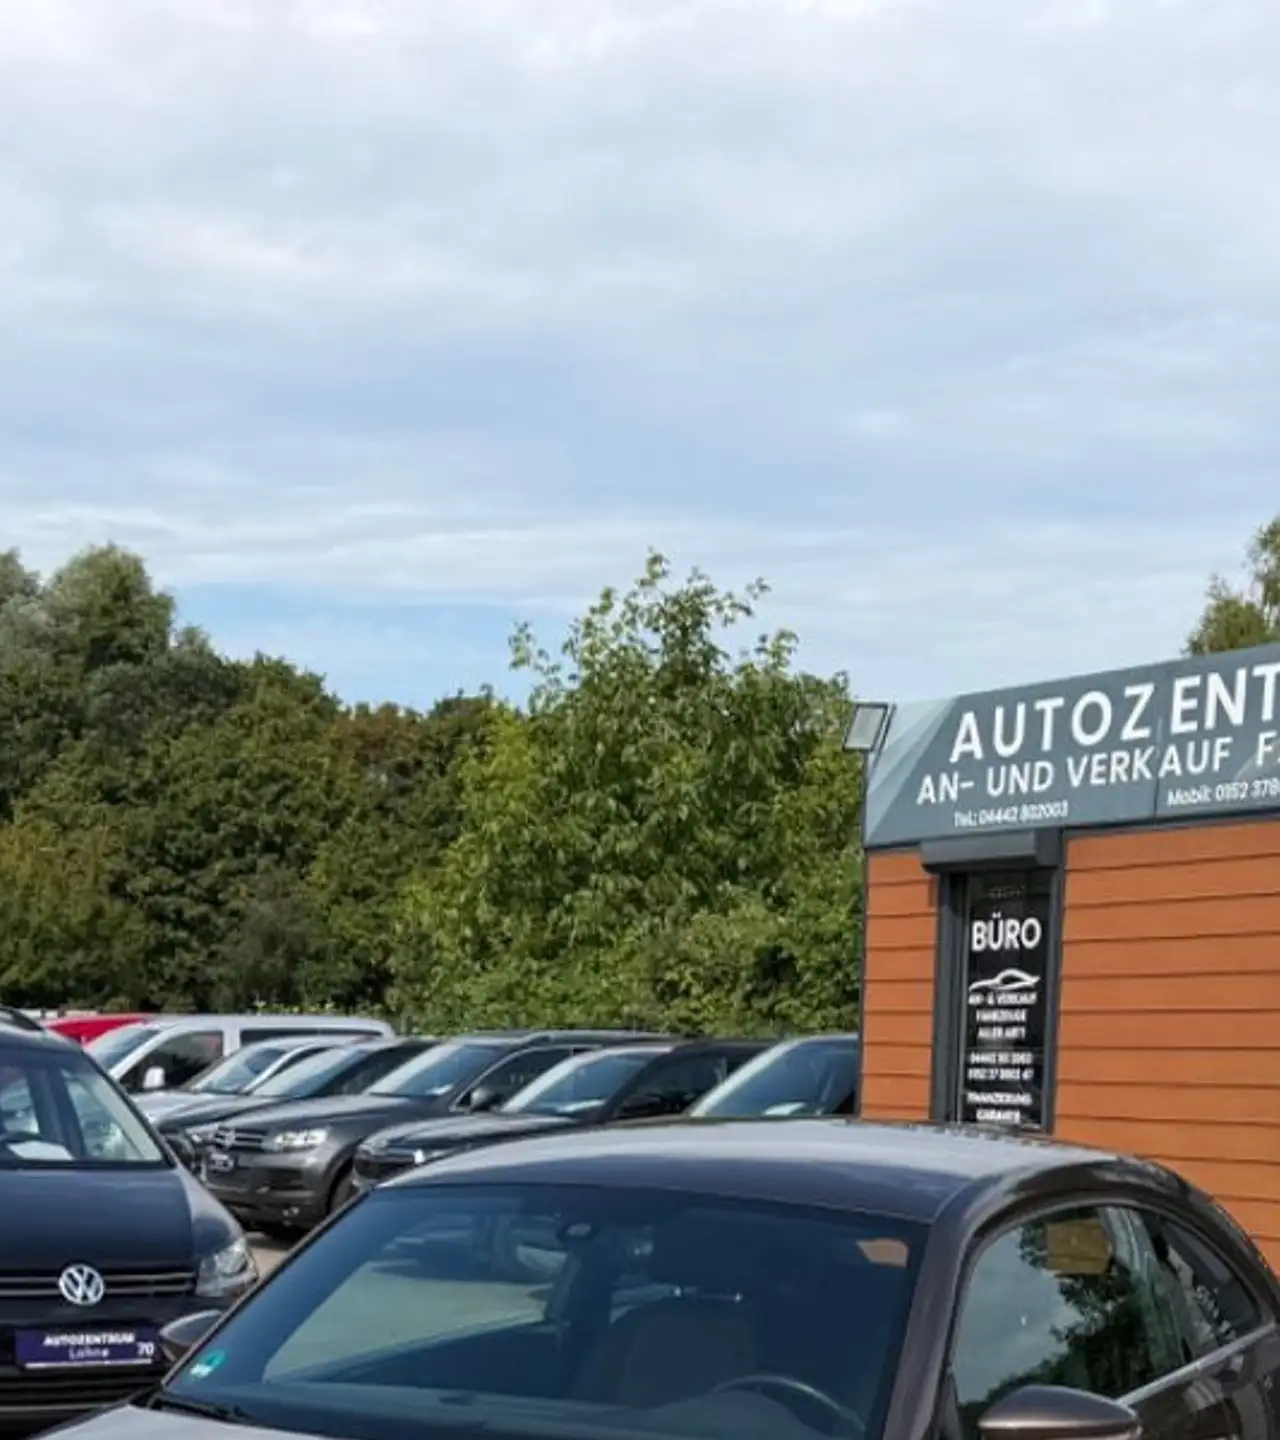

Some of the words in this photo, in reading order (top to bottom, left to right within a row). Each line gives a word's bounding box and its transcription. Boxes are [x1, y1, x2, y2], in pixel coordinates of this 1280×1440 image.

[917, 771, 974, 805] AN-
[987, 760, 1053, 797] UND
[1067, 737, 1232, 787] VERKAUF
[972, 911, 1041, 951] BÜRO
[137, 1342, 154, 1357] 70
